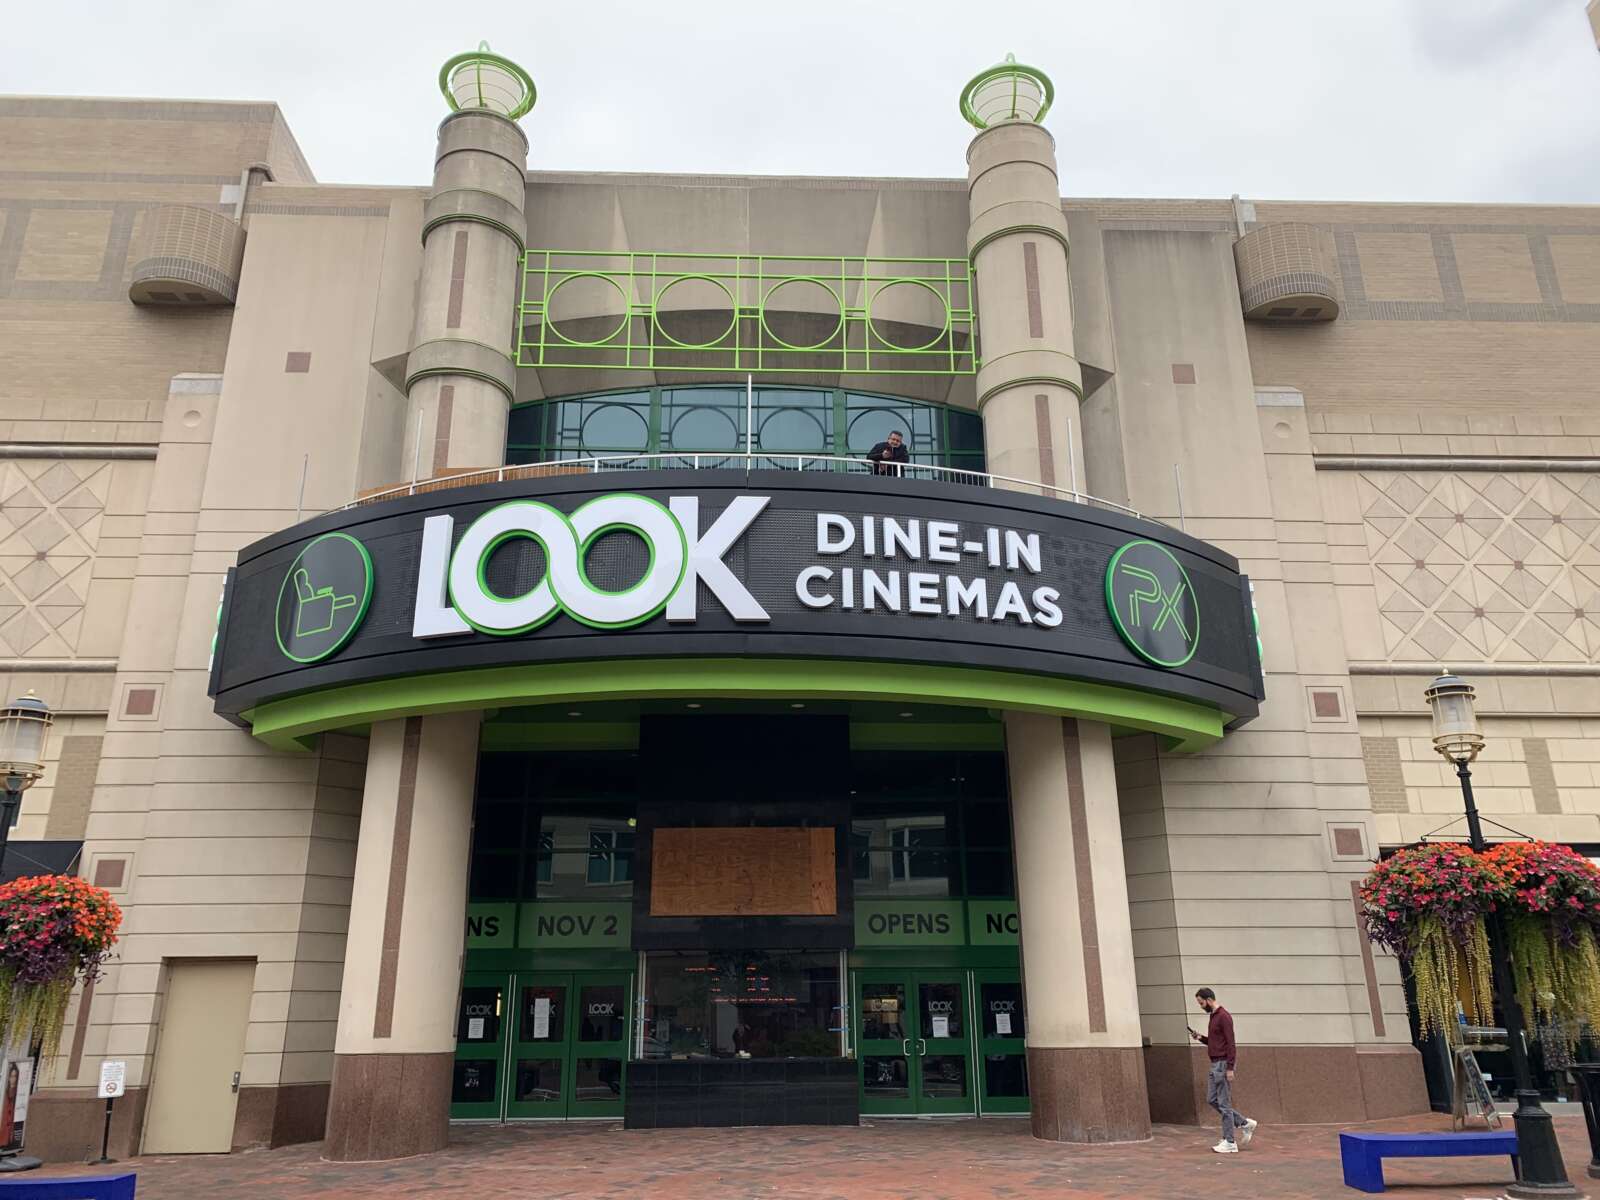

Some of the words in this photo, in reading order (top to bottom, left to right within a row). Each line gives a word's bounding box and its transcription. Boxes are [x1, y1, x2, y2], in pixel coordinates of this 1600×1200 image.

[816, 511, 1042, 574] DINE-IN
[412, 493, 772, 638] LOOK
[795, 565, 1064, 629] CINEMAS
[537, 915, 596, 936] NOV
[603, 915, 618, 936] 2
[868, 913, 950, 934] OPENS
[466, 1004, 492, 1015] LOOK
[588, 1002, 614, 1014] LOOK
[928, 1000, 953, 1011] LOOK
[990, 1000, 1015, 1011] LOOK
